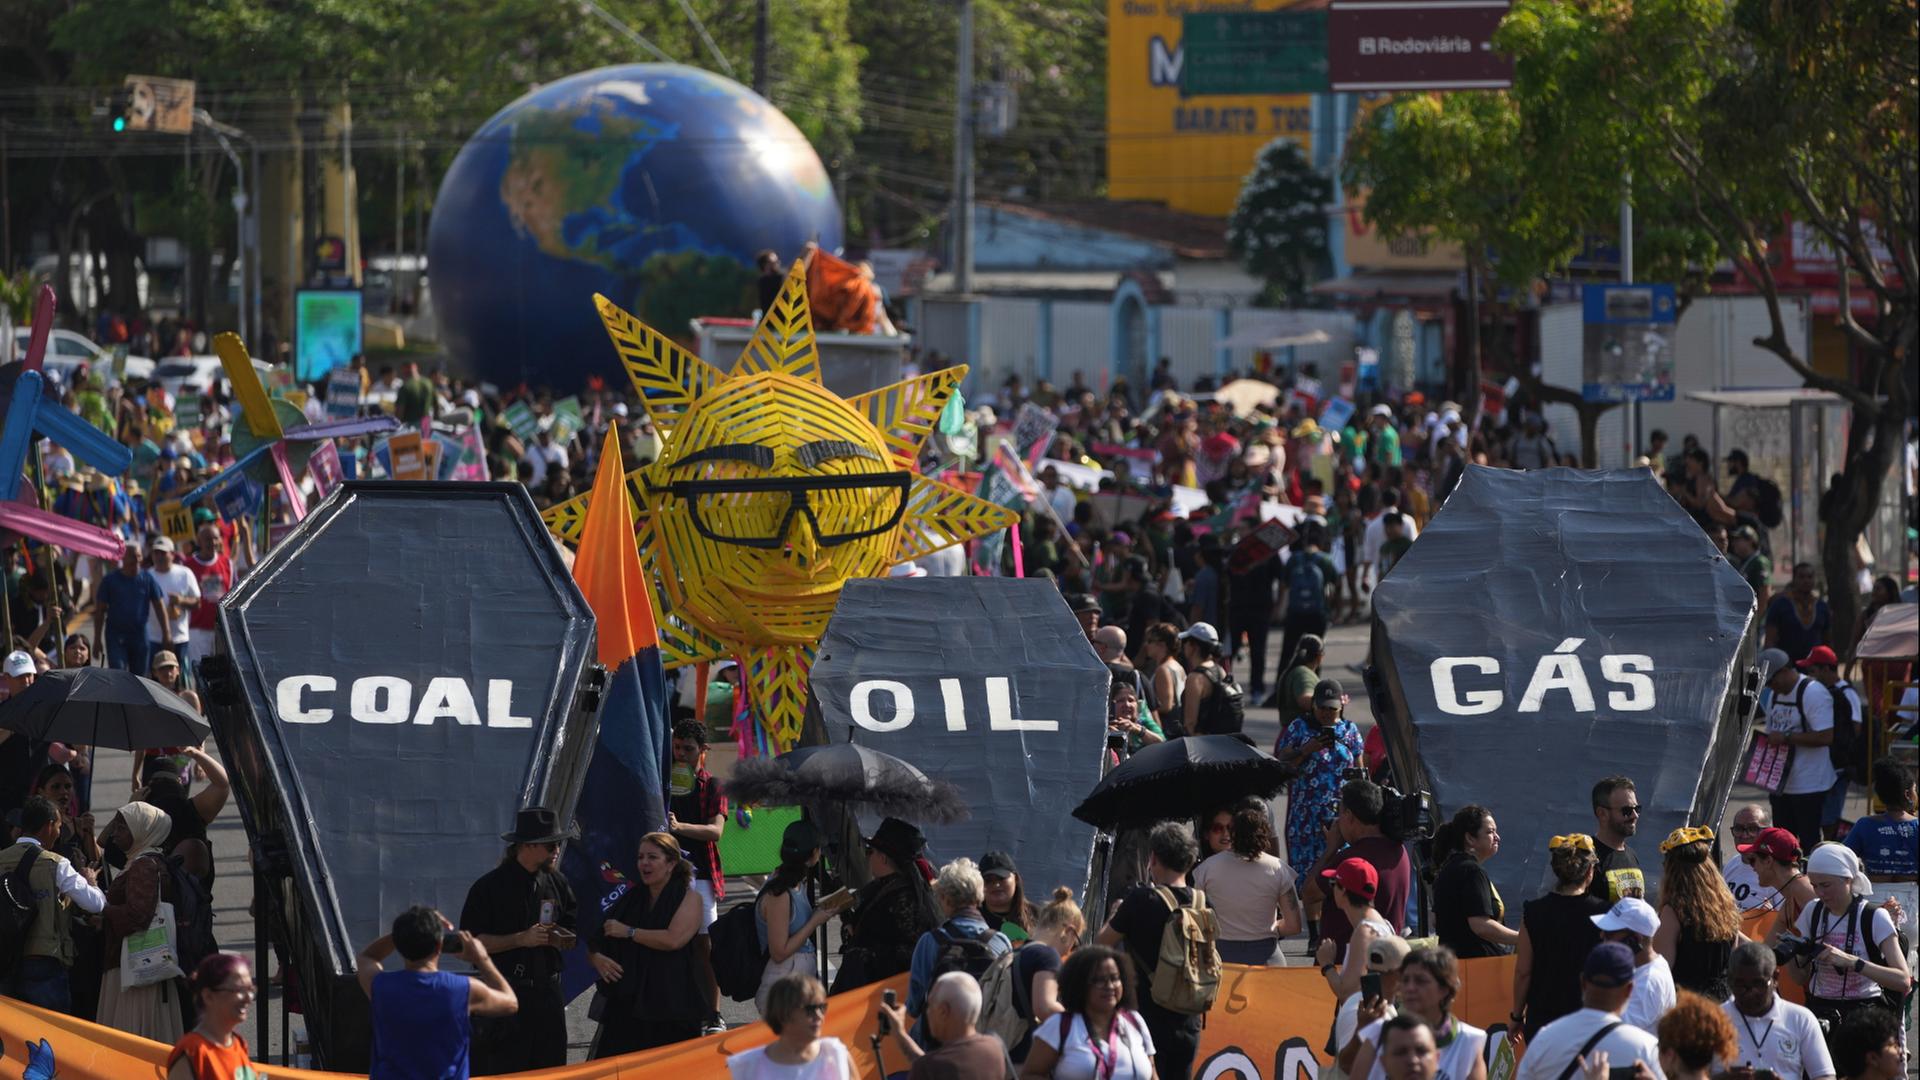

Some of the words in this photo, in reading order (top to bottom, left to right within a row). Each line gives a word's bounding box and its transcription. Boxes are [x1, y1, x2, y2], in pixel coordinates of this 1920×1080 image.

[1378, 36, 1472, 53] Rodoviária
[1174, 108, 1257, 131] BARATO
[276, 675, 532, 728] COAL
[1430, 637, 1655, 715] GÁS
[850, 677, 1059, 732] OIL
